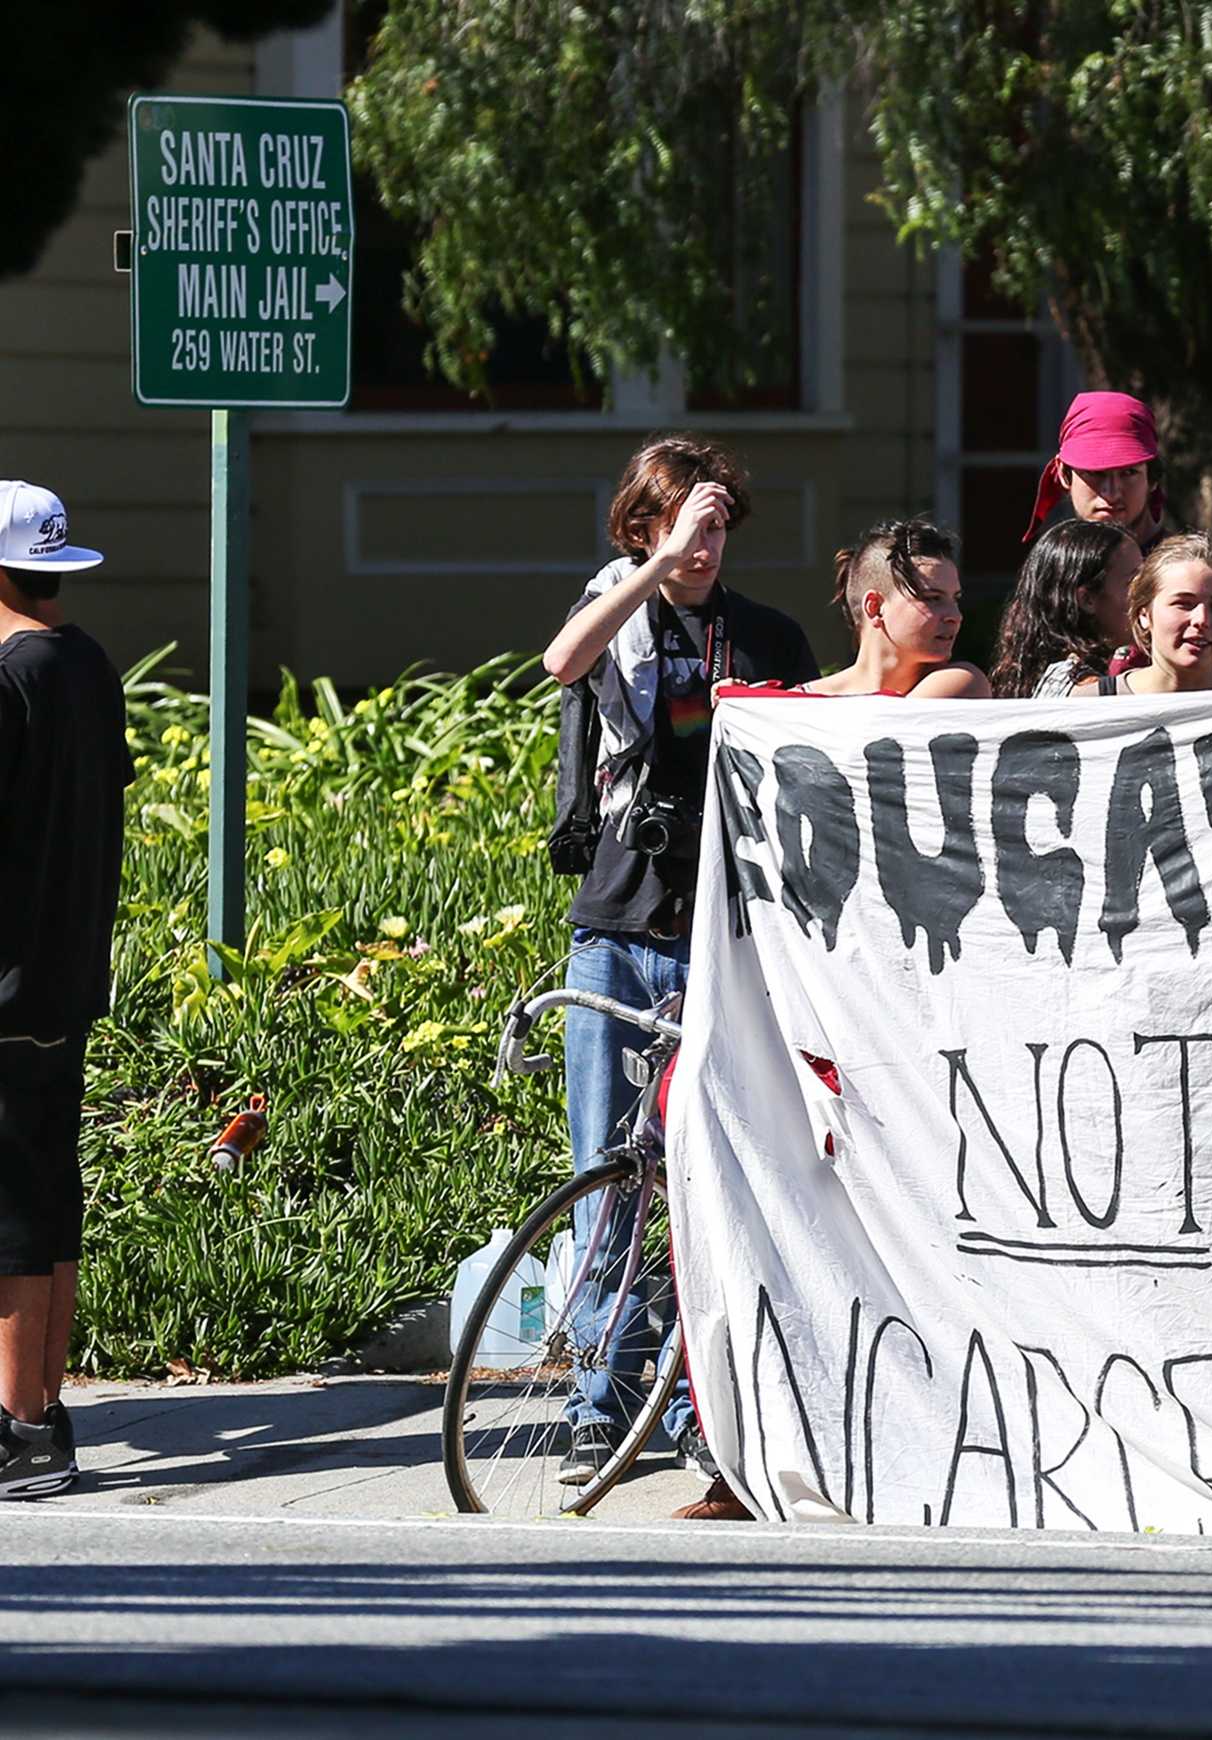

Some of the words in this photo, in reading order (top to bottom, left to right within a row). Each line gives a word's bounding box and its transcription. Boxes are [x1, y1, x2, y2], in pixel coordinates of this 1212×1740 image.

[160, 130, 248, 187] SANTA
[259, 133, 326, 189] CRUZ
[147, 196, 260, 254] SHERIFF'S
[271, 200, 342, 256] OFFICE
[178, 264, 247, 319] MAIN
[259, 266, 313, 320] JAIL
[172, 328, 211, 371] 259
[220, 330, 283, 373] WATER
[293, 333, 320, 374] ST.
